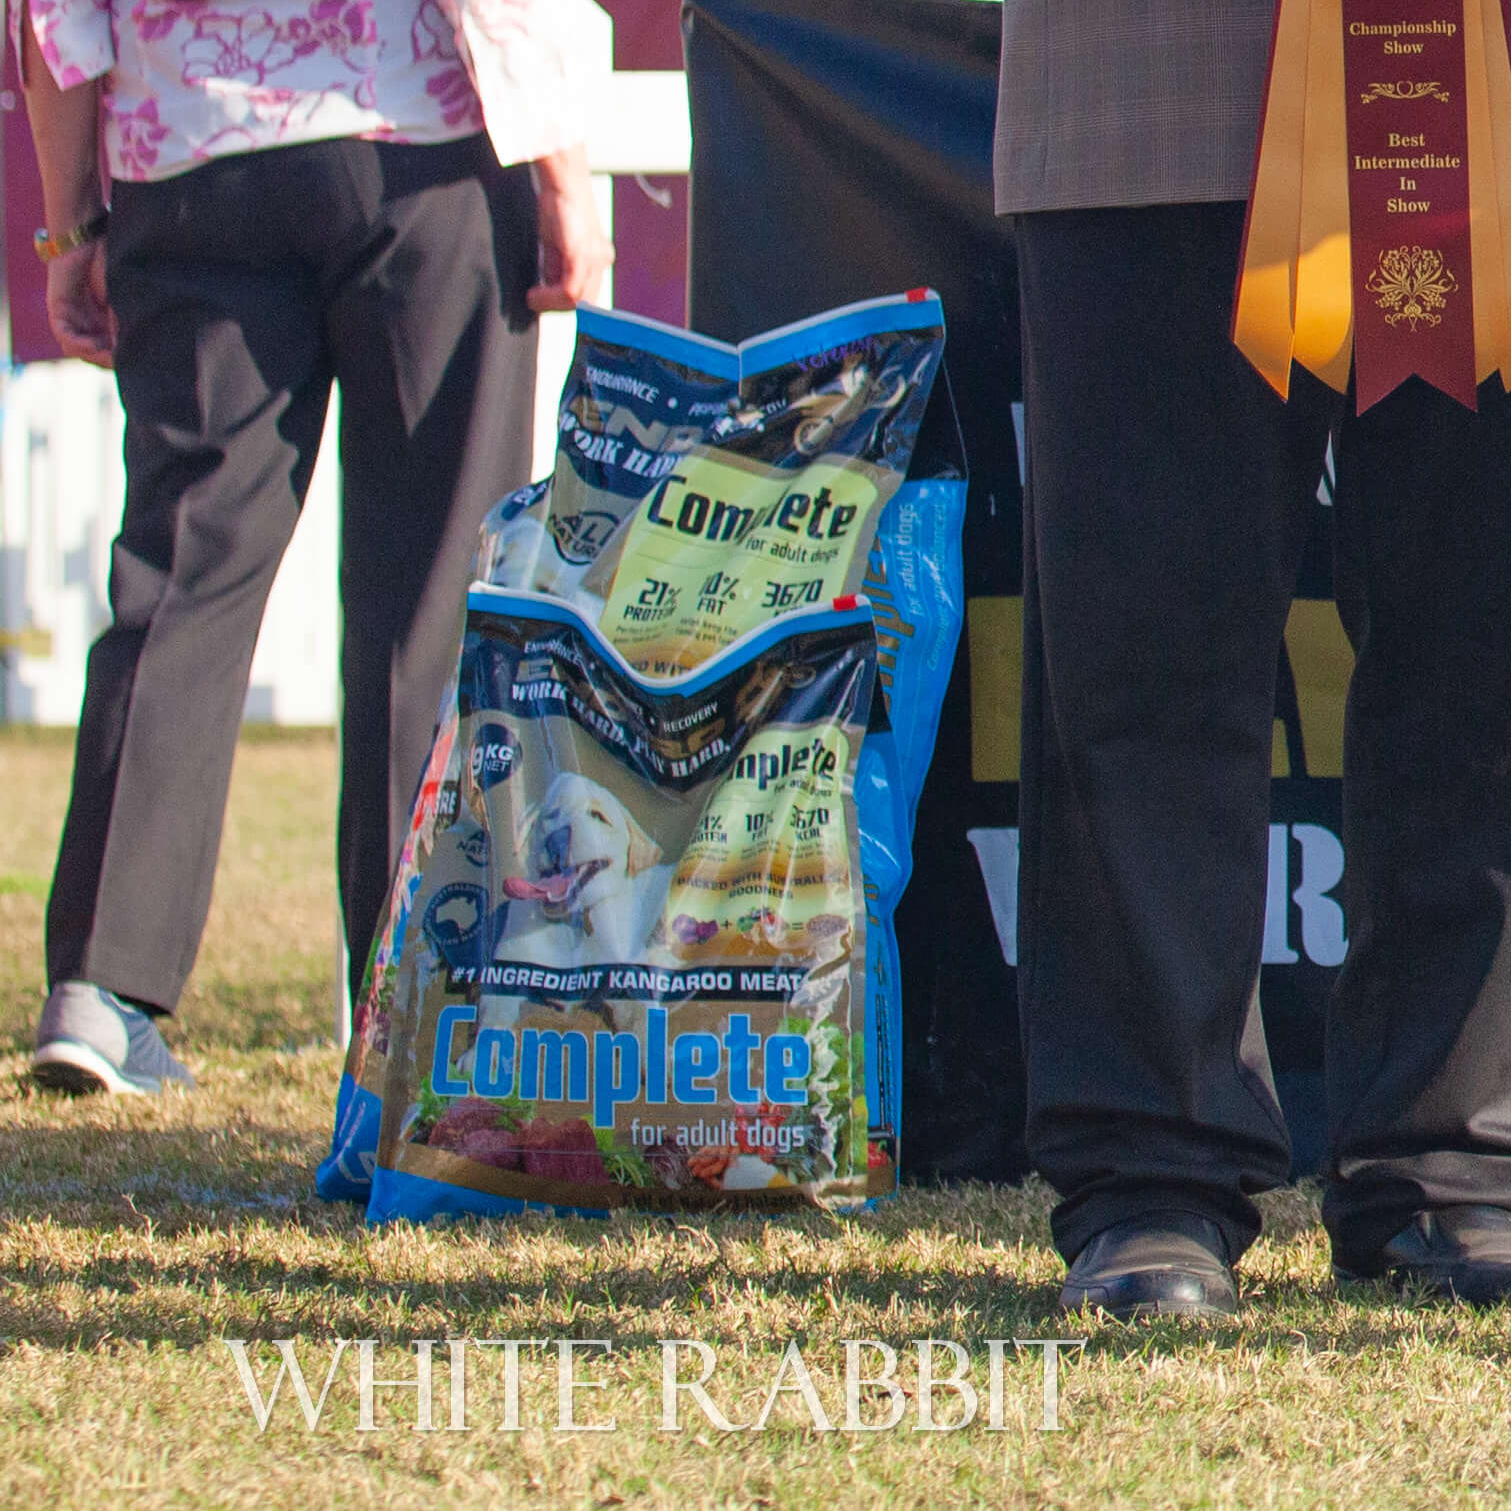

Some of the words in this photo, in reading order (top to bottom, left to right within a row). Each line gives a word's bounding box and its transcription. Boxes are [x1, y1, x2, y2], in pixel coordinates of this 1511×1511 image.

[1349, 20, 1457, 37] Championship
[1383, 40, 1424, 54] Show
[1388, 132, 1425, 148] Best
[1354, 154, 1460, 170] Intermediate
[1399, 176, 1416, 191] In
[1386, 198, 1430, 213] Show
[770, 540, 808, 563] adult
[638, 577, 682, 606] 21%
[761, 577, 824, 609] 3670
[663, 701, 719, 734] RECOVERY
[484, 742, 514, 761] KG
[483, 758, 510, 773] NET
[732, 737, 837, 790] mplete
[451, 968, 477, 985] #1
[480, 967, 603, 992] INGREDIENT
[607, 970, 733, 993] KANGAROO
[739, 968, 804, 992] MEAT
[430, 1003, 812, 1131] Complete
[629, 1117, 661, 1147] for
[674, 1117, 741, 1149] adult
[746, 1117, 807, 1156] dogs
